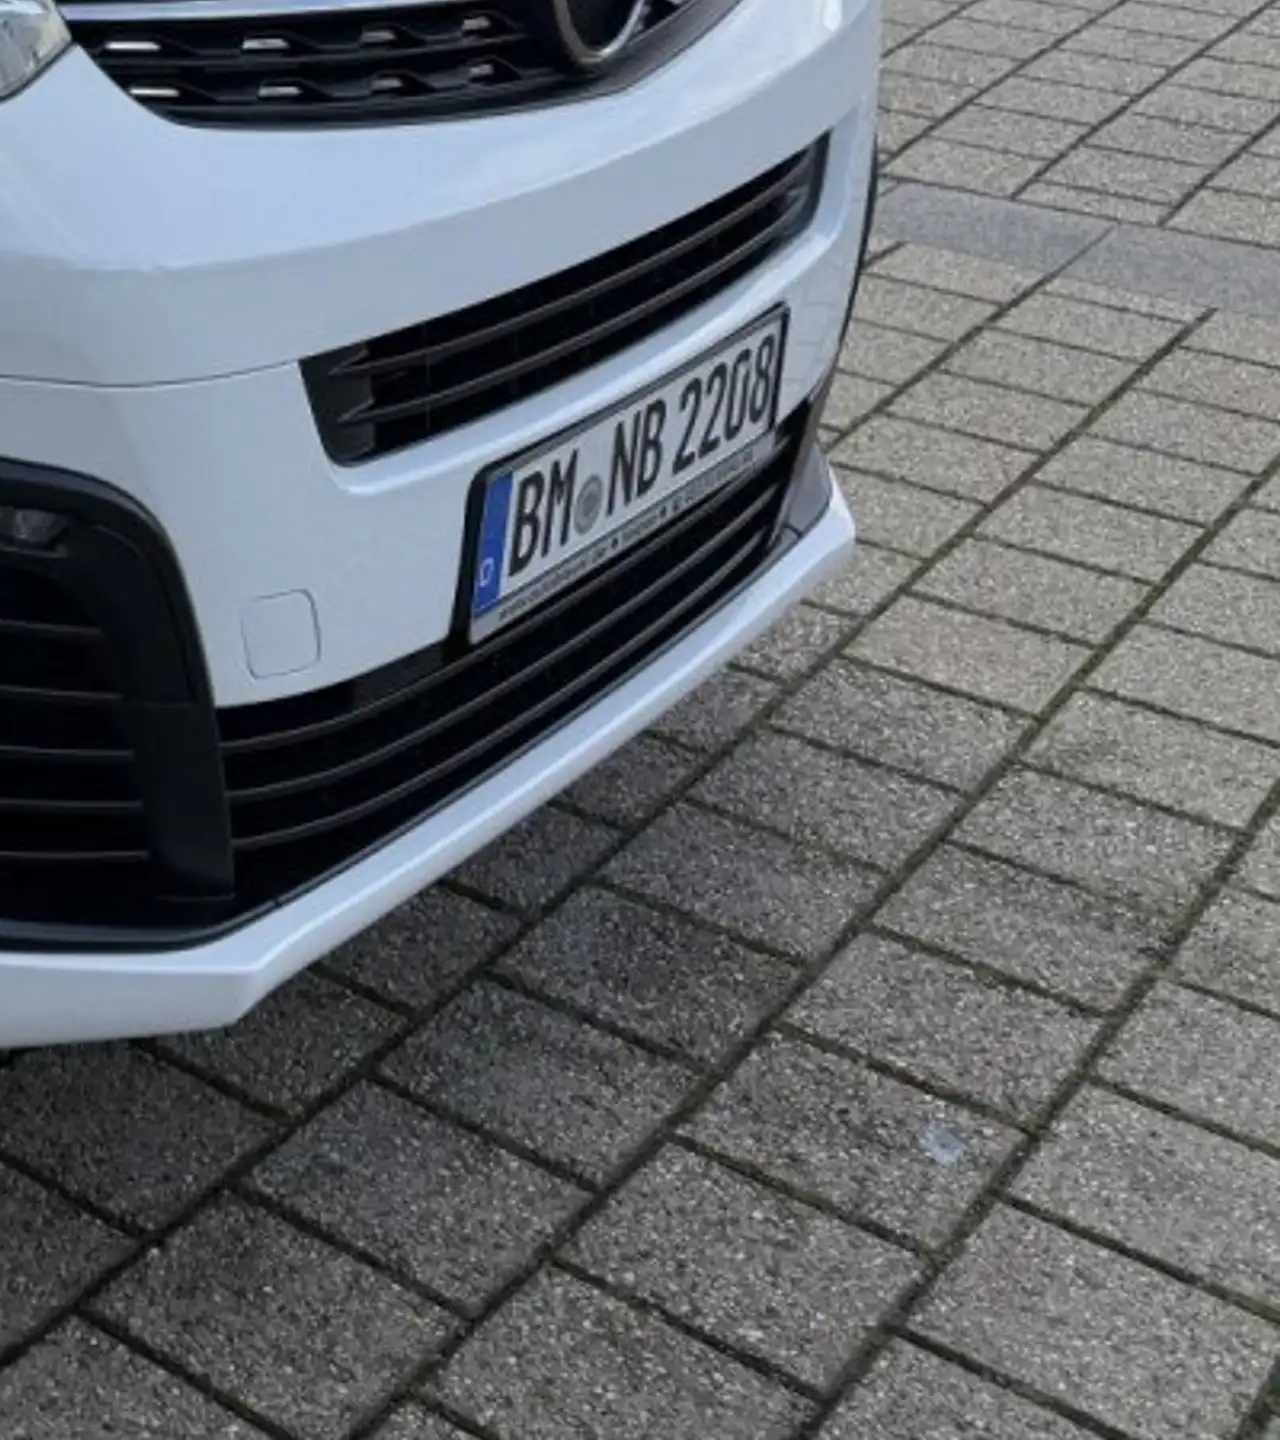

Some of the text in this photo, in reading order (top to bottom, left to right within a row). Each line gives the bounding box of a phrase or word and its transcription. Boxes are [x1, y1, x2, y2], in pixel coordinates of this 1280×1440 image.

[509, 449, 578, 577] BM
[607, 399, 667, 516] NB
[672, 334, 776, 475] 2208
